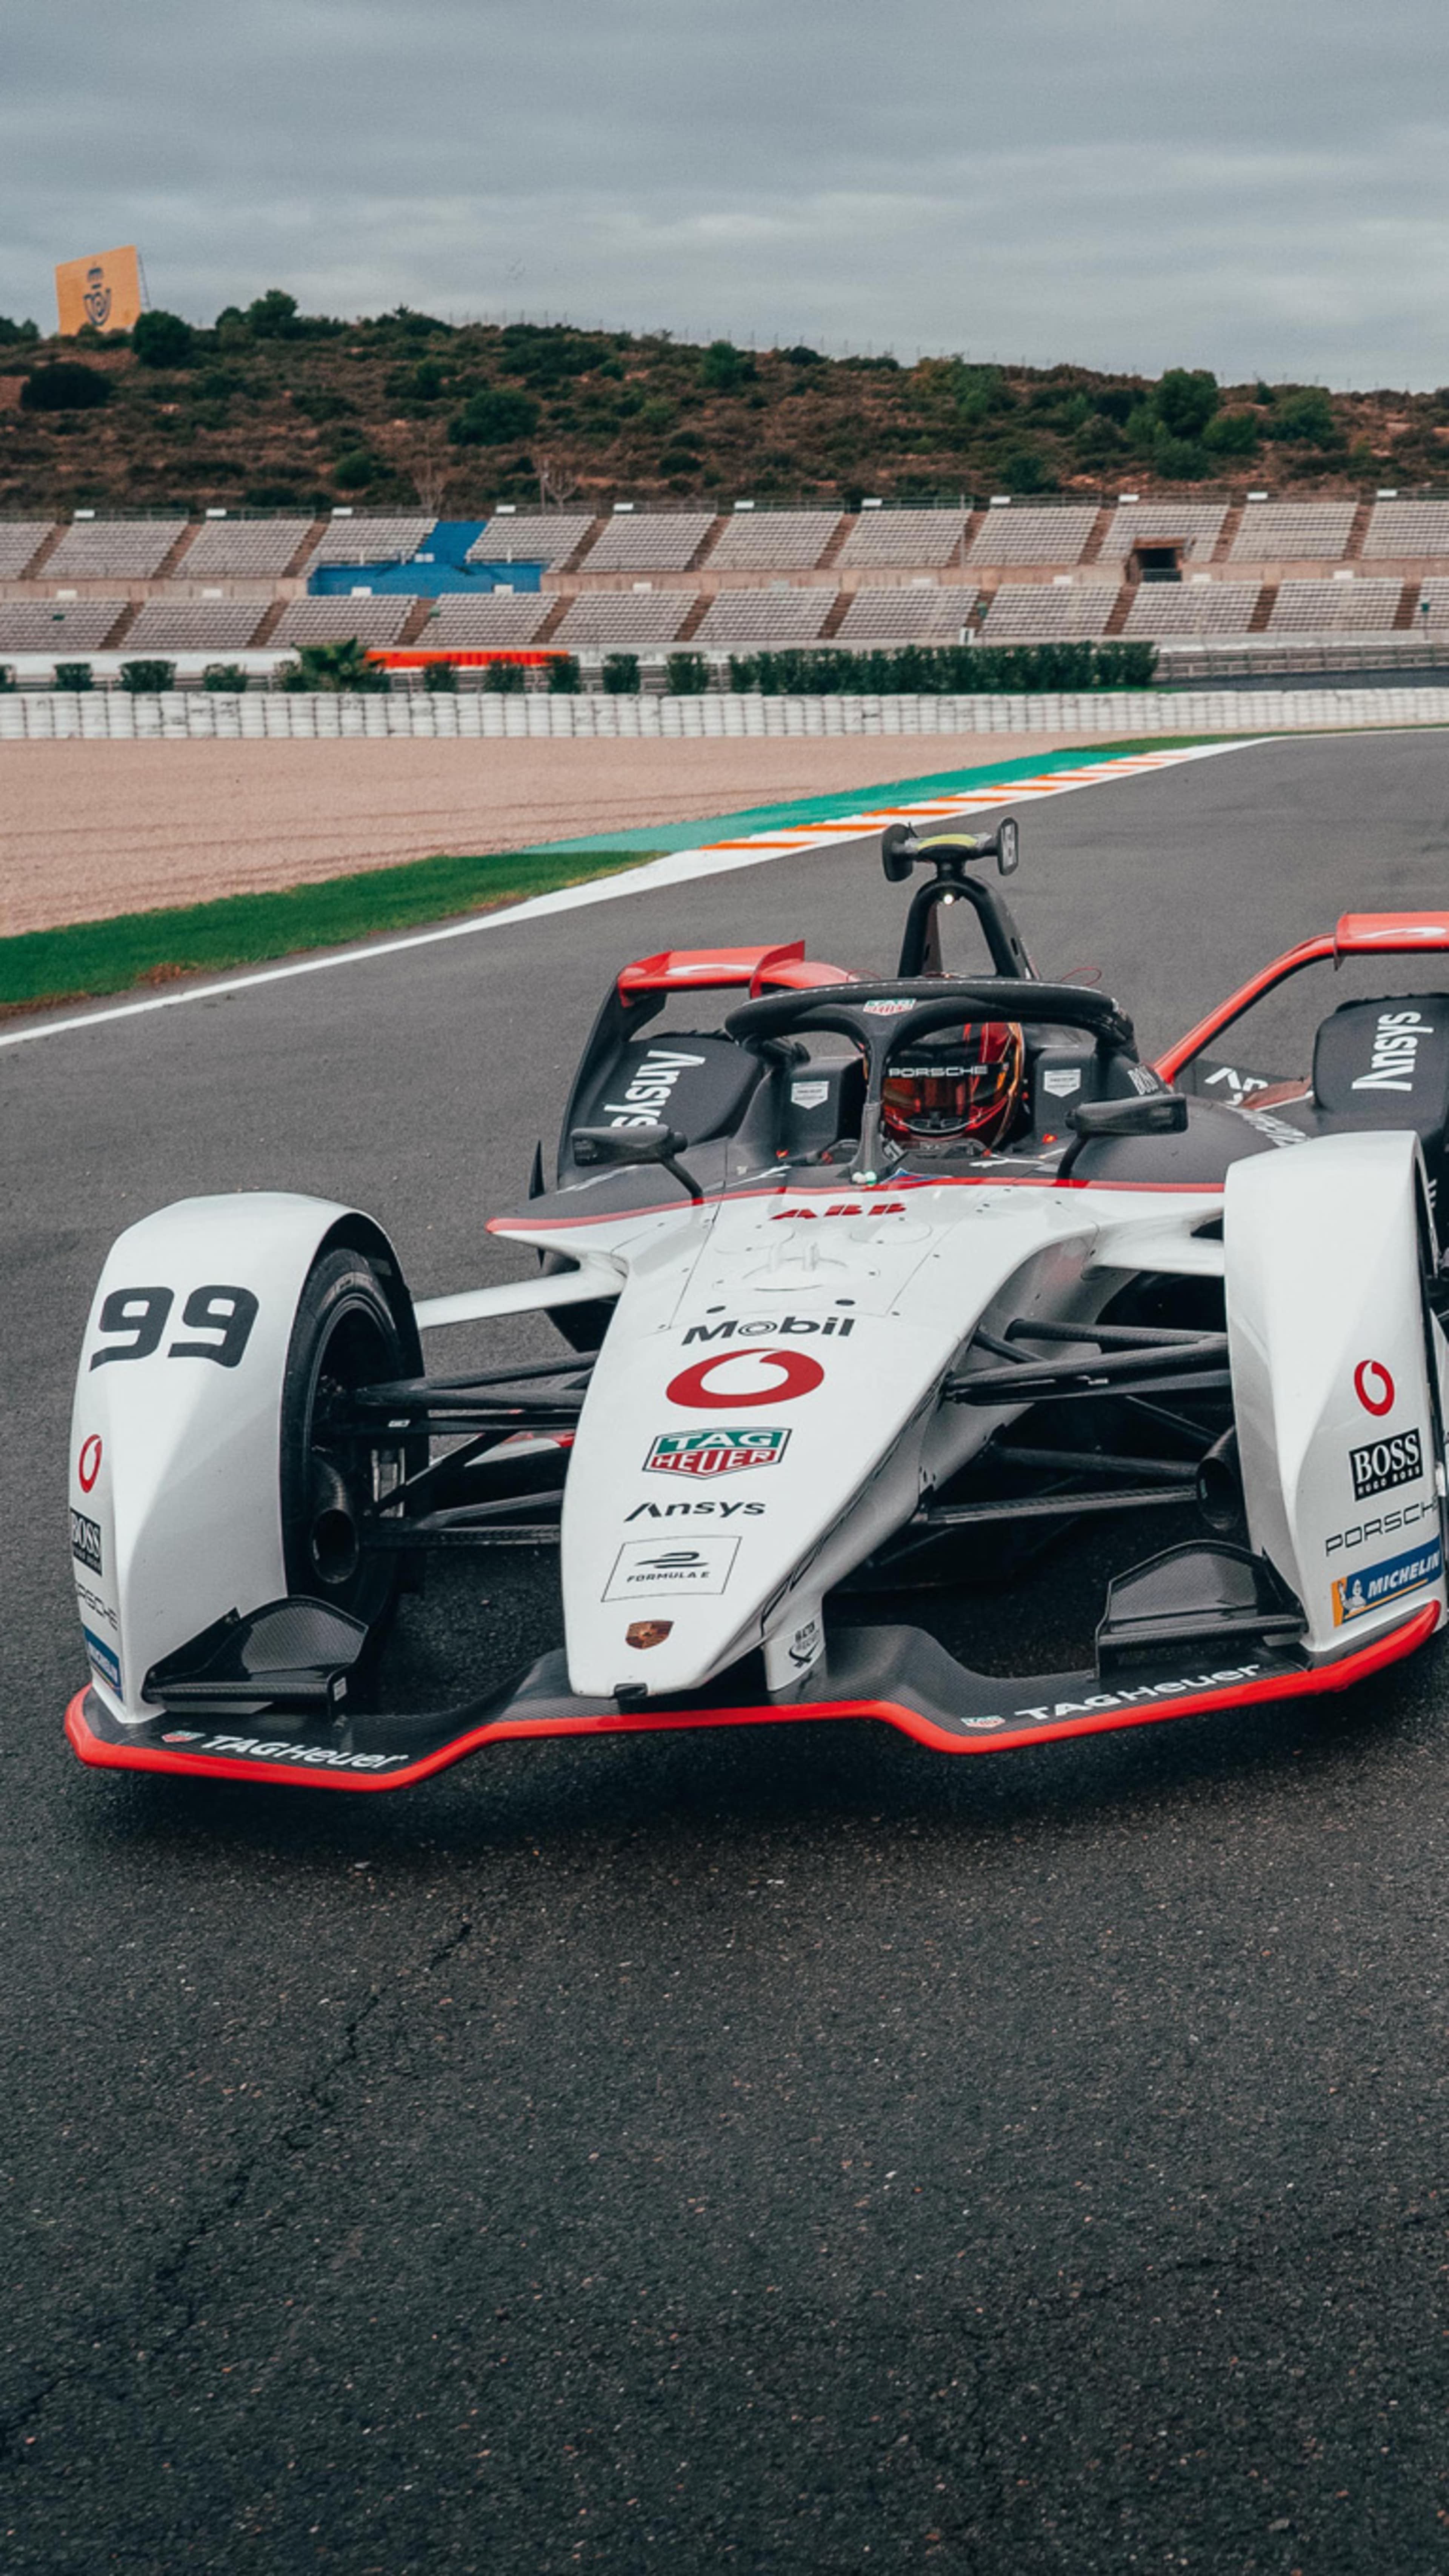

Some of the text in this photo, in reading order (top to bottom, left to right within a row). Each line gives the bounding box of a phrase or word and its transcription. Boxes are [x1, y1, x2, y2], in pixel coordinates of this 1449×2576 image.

[1351, 1011, 1434, 1091] Ansys
[604, 1050, 706, 1127] Ansys
[889, 1066, 988, 1078] PORSCHE
[89, 1285, 260, 1372] 99
[681, 1316, 855, 1346] Mobil
[667, 1431, 775, 1450] TAG
[1354, 1434, 1420, 1484] BOSS
[655, 1450, 771, 1472] HEUER
[623, 1502, 766, 1523] Ansys
[1325, 1496, 1438, 1557] PORSCH
[626, 1571, 697, 1583] FORMULA
[1368, 1550, 1440, 1599] MICHELIN
